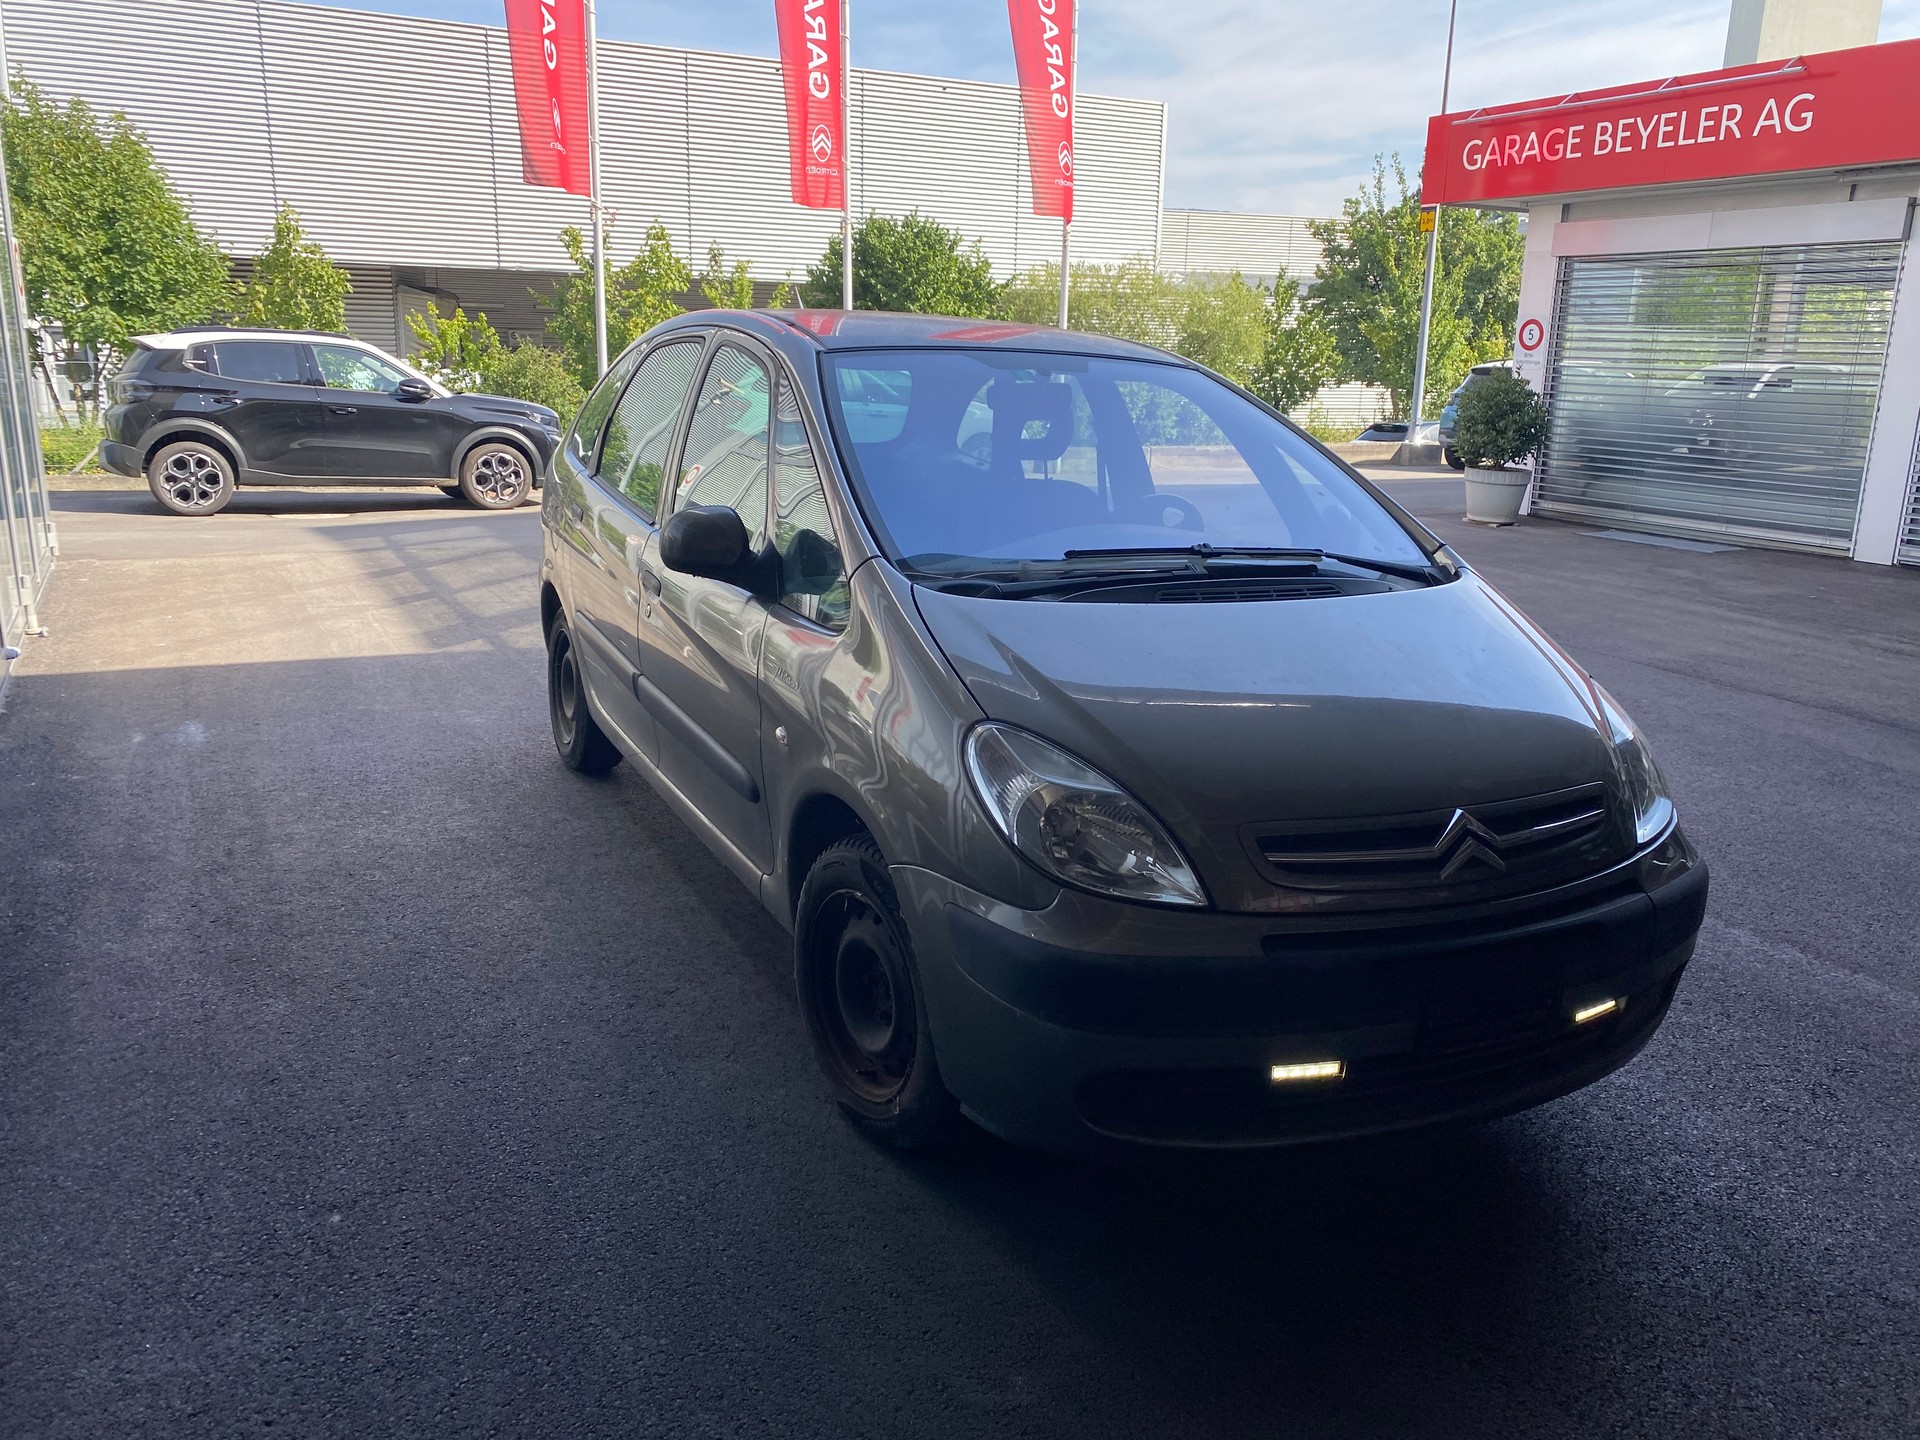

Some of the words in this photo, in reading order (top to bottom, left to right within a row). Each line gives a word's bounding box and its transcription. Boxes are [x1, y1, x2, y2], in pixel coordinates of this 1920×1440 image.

[1463, 124, 1584, 171] GARAGE
[1593, 103, 1741, 155] BEYELER
[1752, 92, 1816, 137] AG
[1528, 328, 1534, 341] 5
